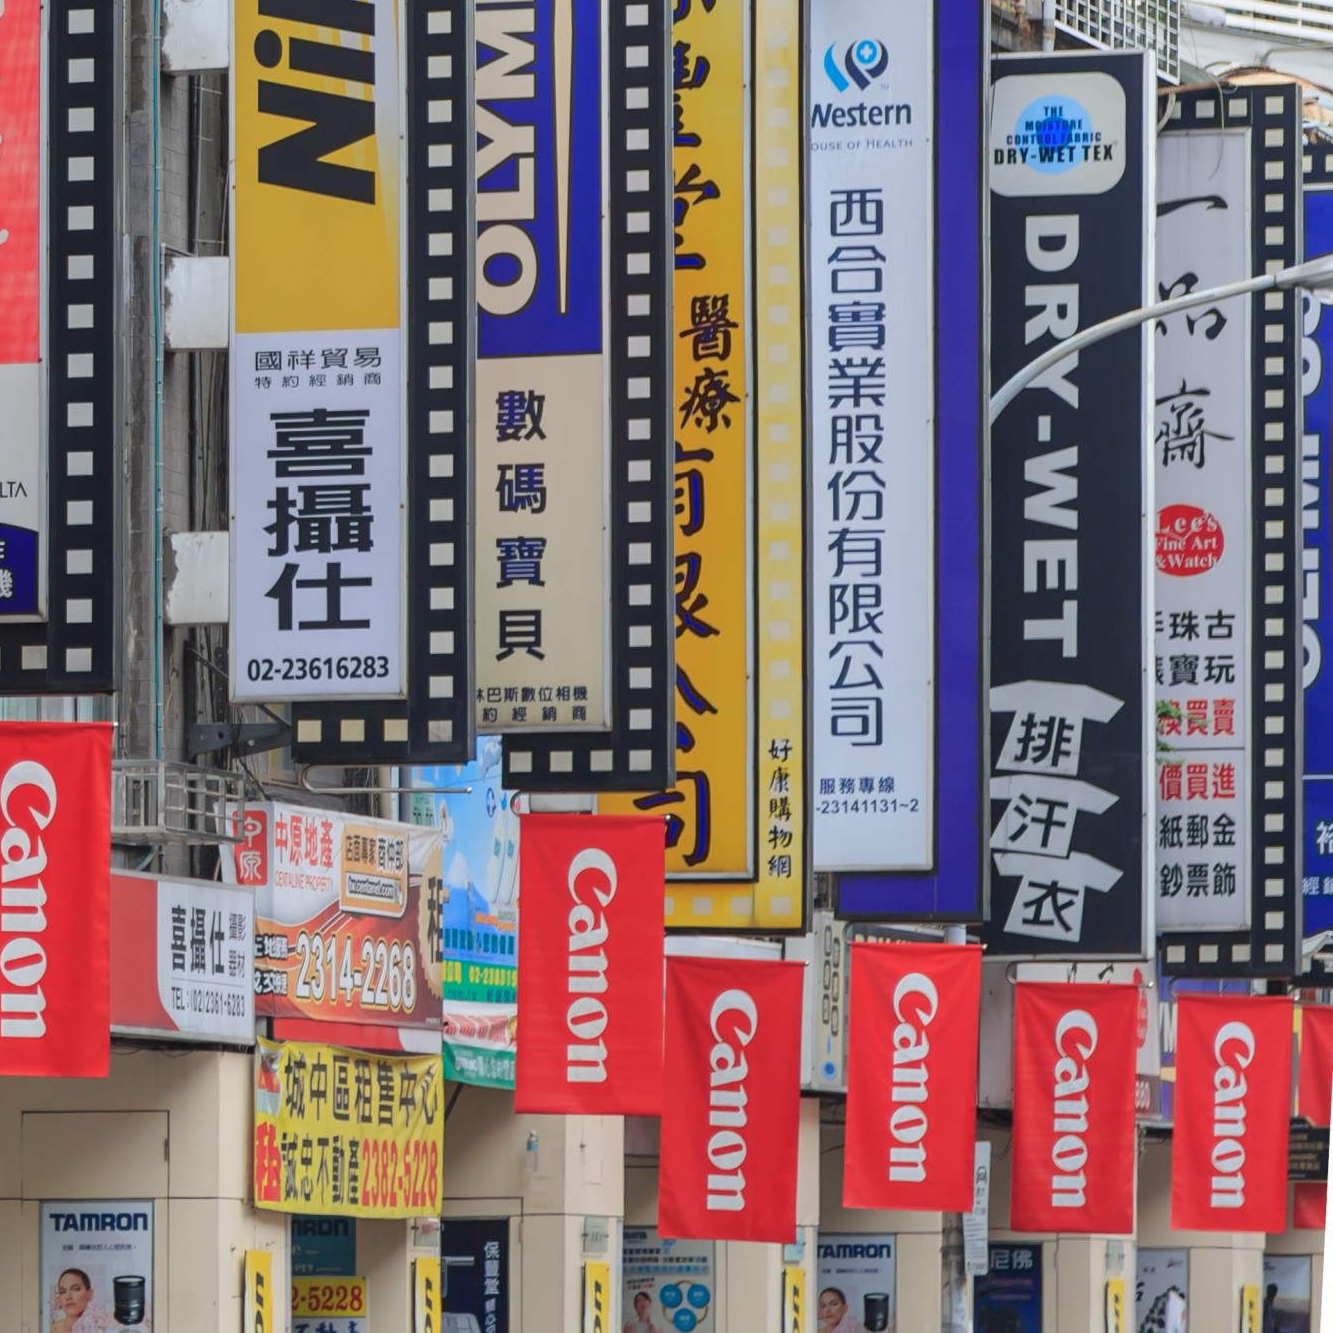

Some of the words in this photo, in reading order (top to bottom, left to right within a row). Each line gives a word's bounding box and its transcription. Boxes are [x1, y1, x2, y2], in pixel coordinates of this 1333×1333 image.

[811, 103, 911, 128] Western
[1006, 134, 1059, 146] CONTROL
[1061, 132, 1102, 144] FABRIC
[1025, 119, 1083, 132] MOISTURE
[1044, 106, 1063, 116] THE
[847, 141, 861, 150] OF
[867, 138, 913, 149] HEALTH
[994, 145, 1075, 165] DRY-WET
[1082, 144, 1113, 162] TEX
[254, 347, 382, 371] 國祥貿易
[254, 372, 382, 390] 特約經銷商
[1023, 214, 1080, 658] DRY-WET
[828, 188, 886, 747] 西合實業股份有限公司
[265, 408, 374, 631] 喜攝仕
[495, 390, 546, 661] 數碼寶貝
[1157, 511, 1218, 535] Lee's
[1191, 535, 1218, 550] Art
[1156, 552, 1218, 569] &Watch
[247, 656, 389, 682] 02-23616283
[769, 738, 792, 879] 好康購物網
[820, 776, 895, 795] 服務專線
[275, 813, 333, 870] 中原地產
[1009, 714, 1079, 932] 排汗衣
[0, 760, 57, 1038] Canon
[275, 870, 304, 889] CENTALINE
[305, 874, 333, 894] PROPERTY
[295, 930, 416, 1014] 2314-2268
[566, 847, 619, 1083] Canon
[284, 1051, 437, 1127] 城中區租售中心
[706, 988, 758, 1212] Canon
[888, 972, 939, 1183] Canon
[1051, 1009, 1098, 1208] Canon
[1210, 1021, 1255, 1208] Canon
[281, 1133, 359, 1205] 誠忠不動產
[362, 1138, 438, 1208] 2382-5228
[49, 1212, 148, 1232] TAMRON
